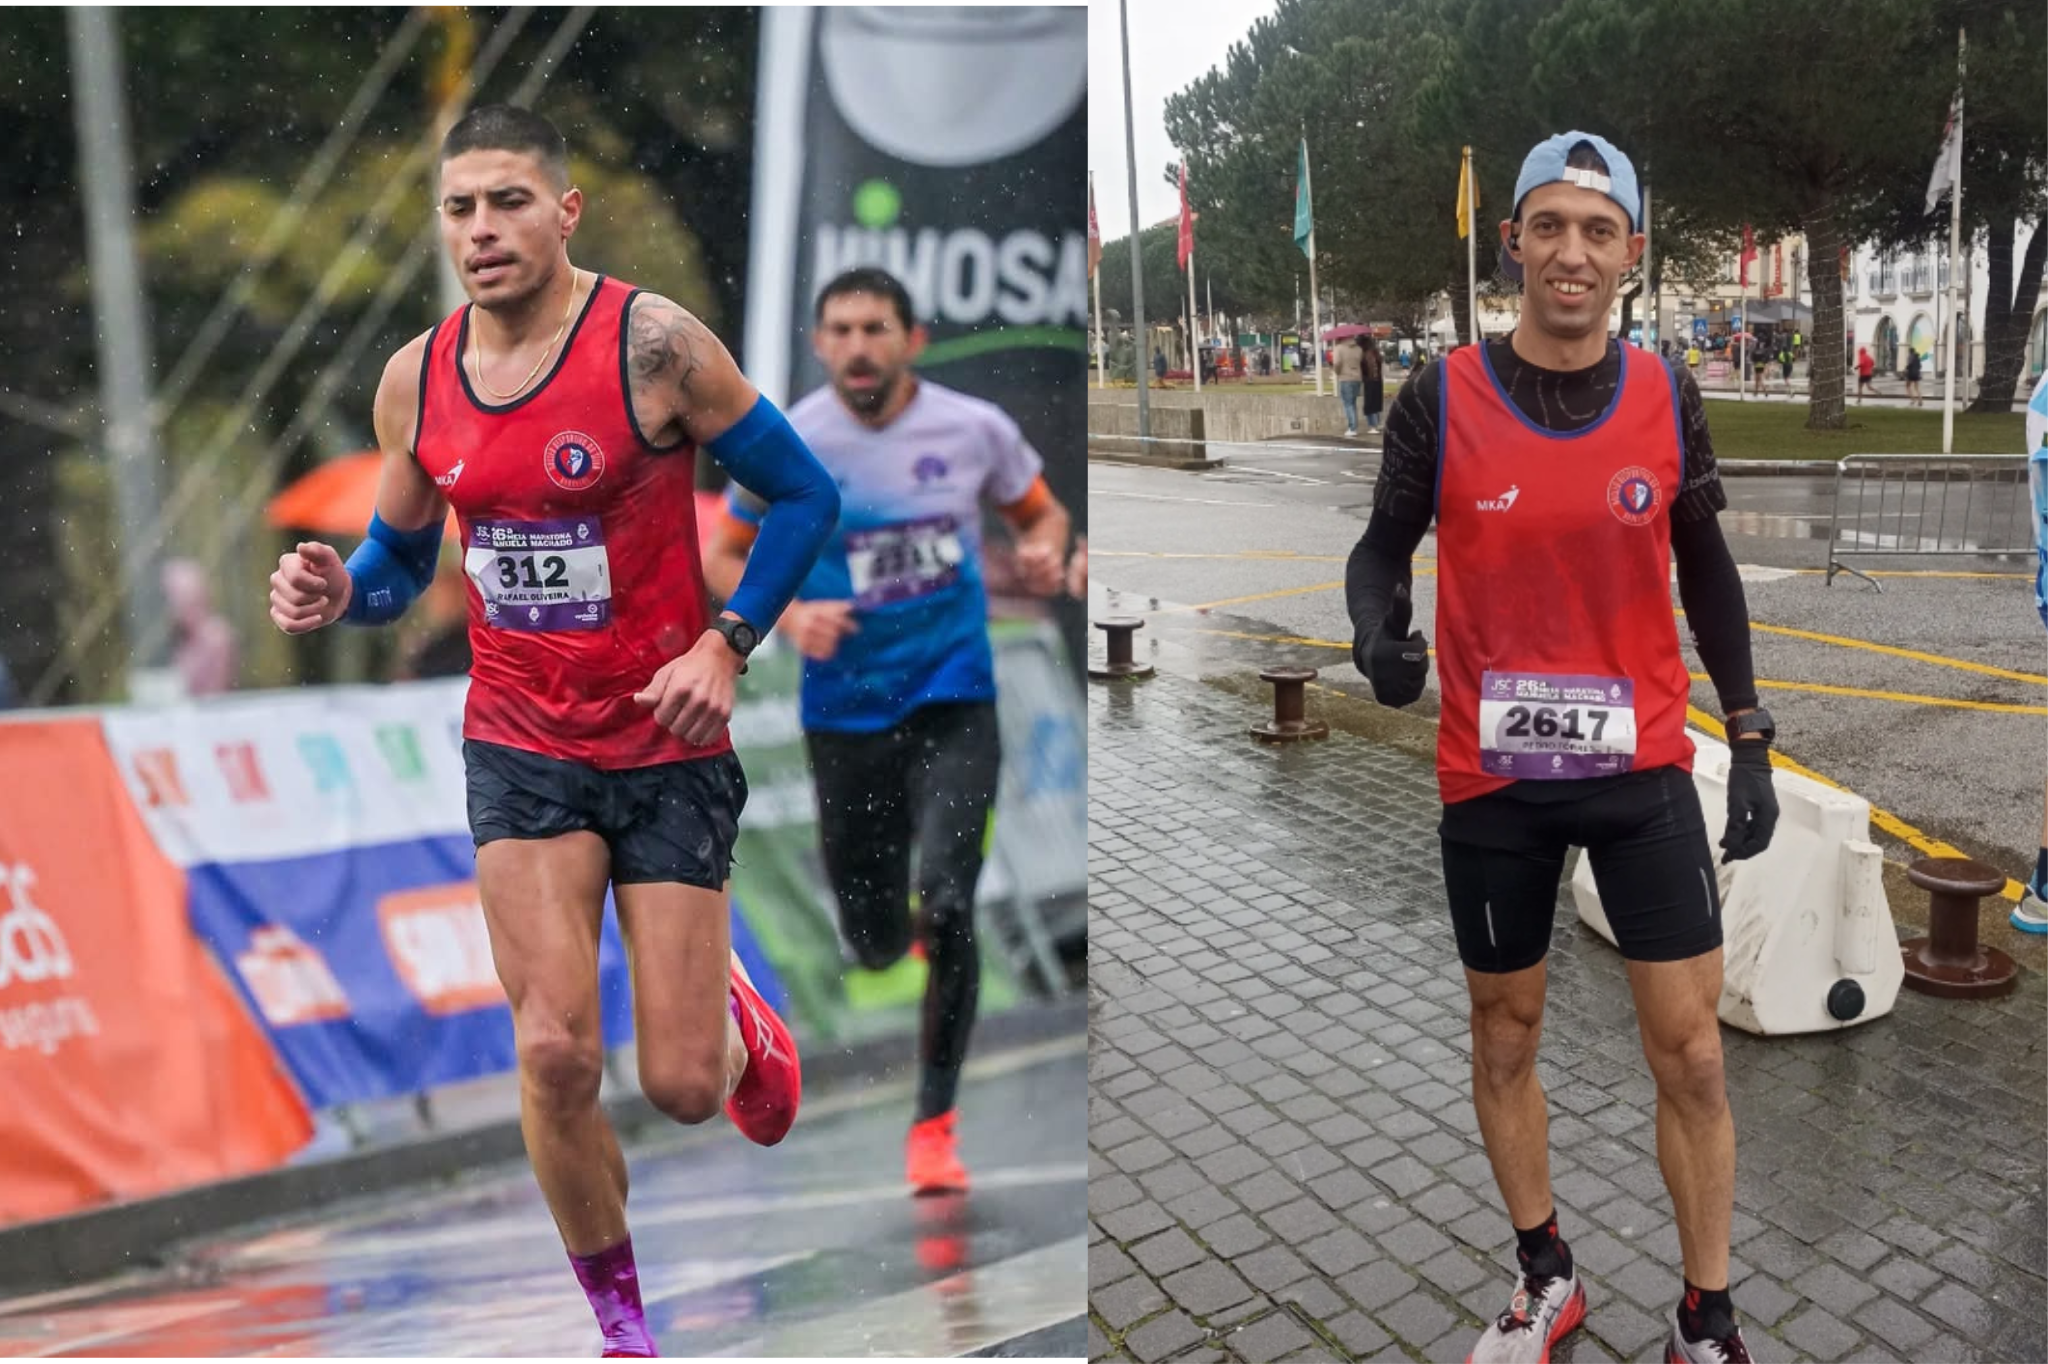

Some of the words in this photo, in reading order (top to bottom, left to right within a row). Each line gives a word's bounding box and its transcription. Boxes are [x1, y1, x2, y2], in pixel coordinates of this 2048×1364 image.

[1475, 500, 1505, 511] MKA
[497, 556, 569, 589] 312
[530, 592, 570, 602] OLIVEIRA
[1505, 705, 1609, 741] 2617
